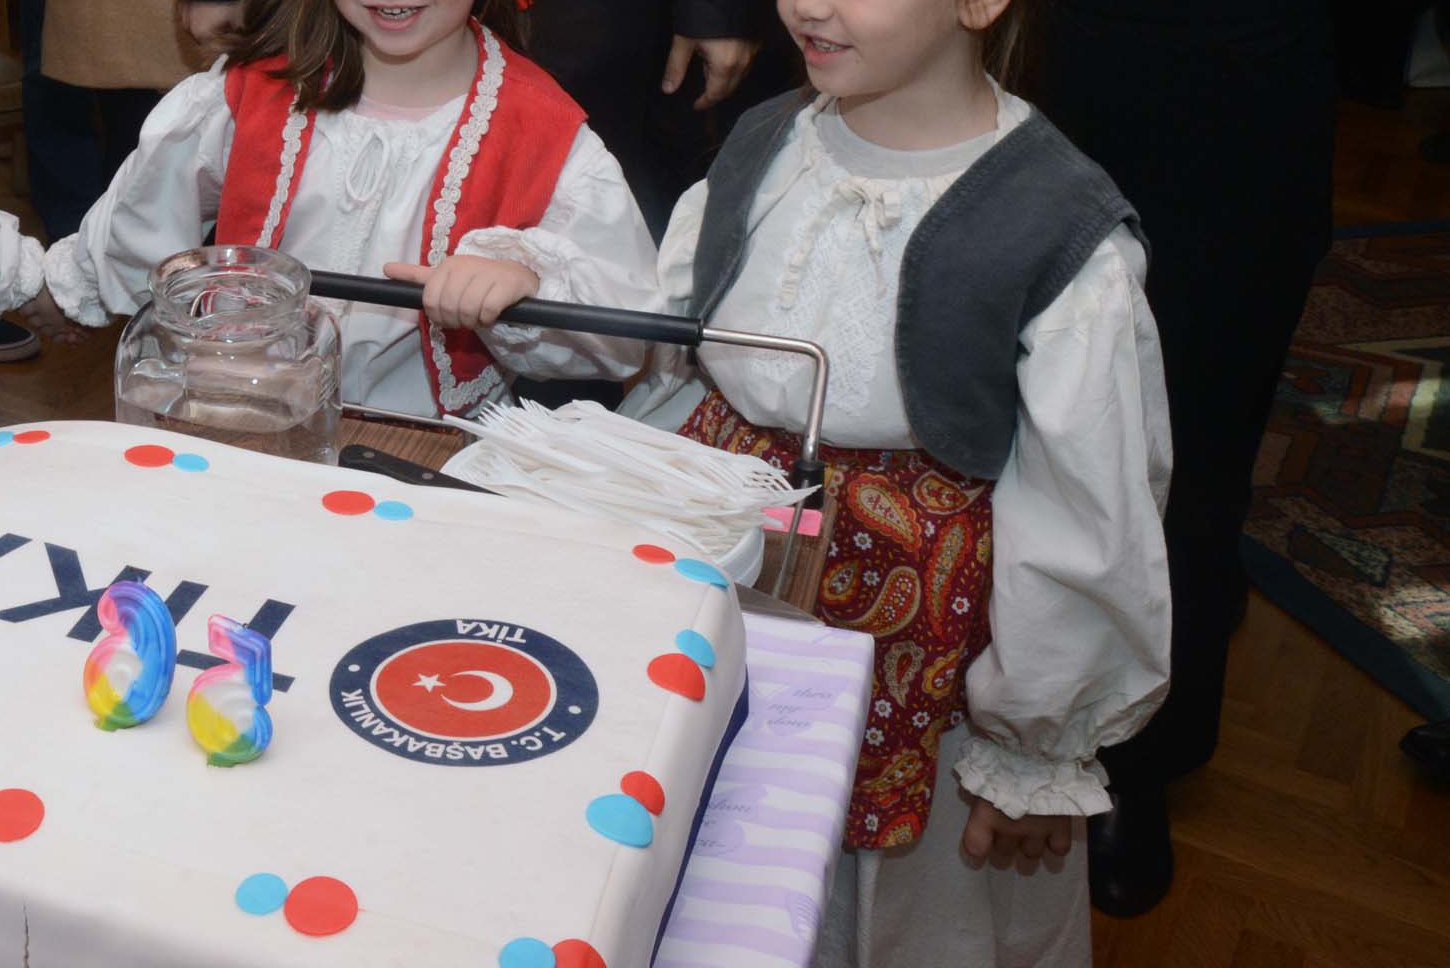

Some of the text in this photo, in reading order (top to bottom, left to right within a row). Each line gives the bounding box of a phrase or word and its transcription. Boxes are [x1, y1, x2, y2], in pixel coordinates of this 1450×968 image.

[455, 620, 528, 644] TİKA
[340, 688, 566, 760] T.C. BAŞBAKANLIK
